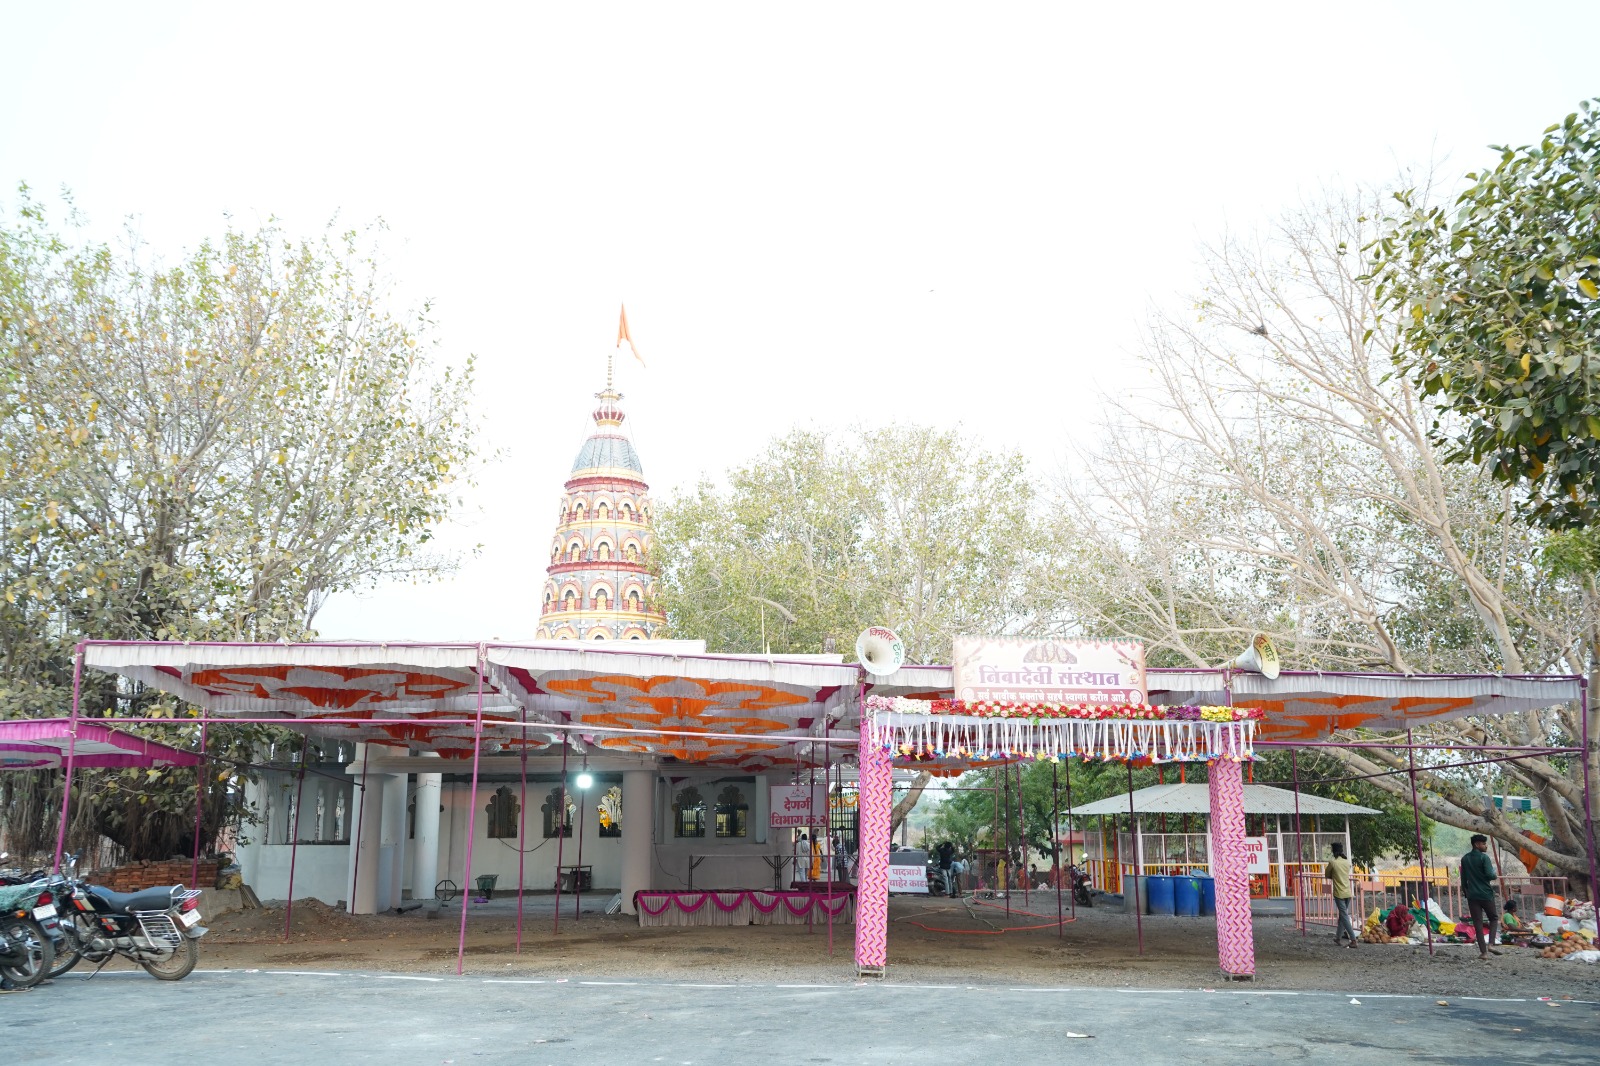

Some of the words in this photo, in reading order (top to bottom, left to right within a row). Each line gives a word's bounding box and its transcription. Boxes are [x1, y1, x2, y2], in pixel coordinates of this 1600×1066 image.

[1057, 666, 1120, 686] संस्थान
[977, 690, 990, 702] सर्व
[1019, 690, 1045, 703] भक्तांचे
[1065, 692, 1088, 703] स्वागत
[1090, 692, 1109, 703] करीत
[784, 797, 811, 811] देणगी
[771, 812, 804, 825] विभाग
